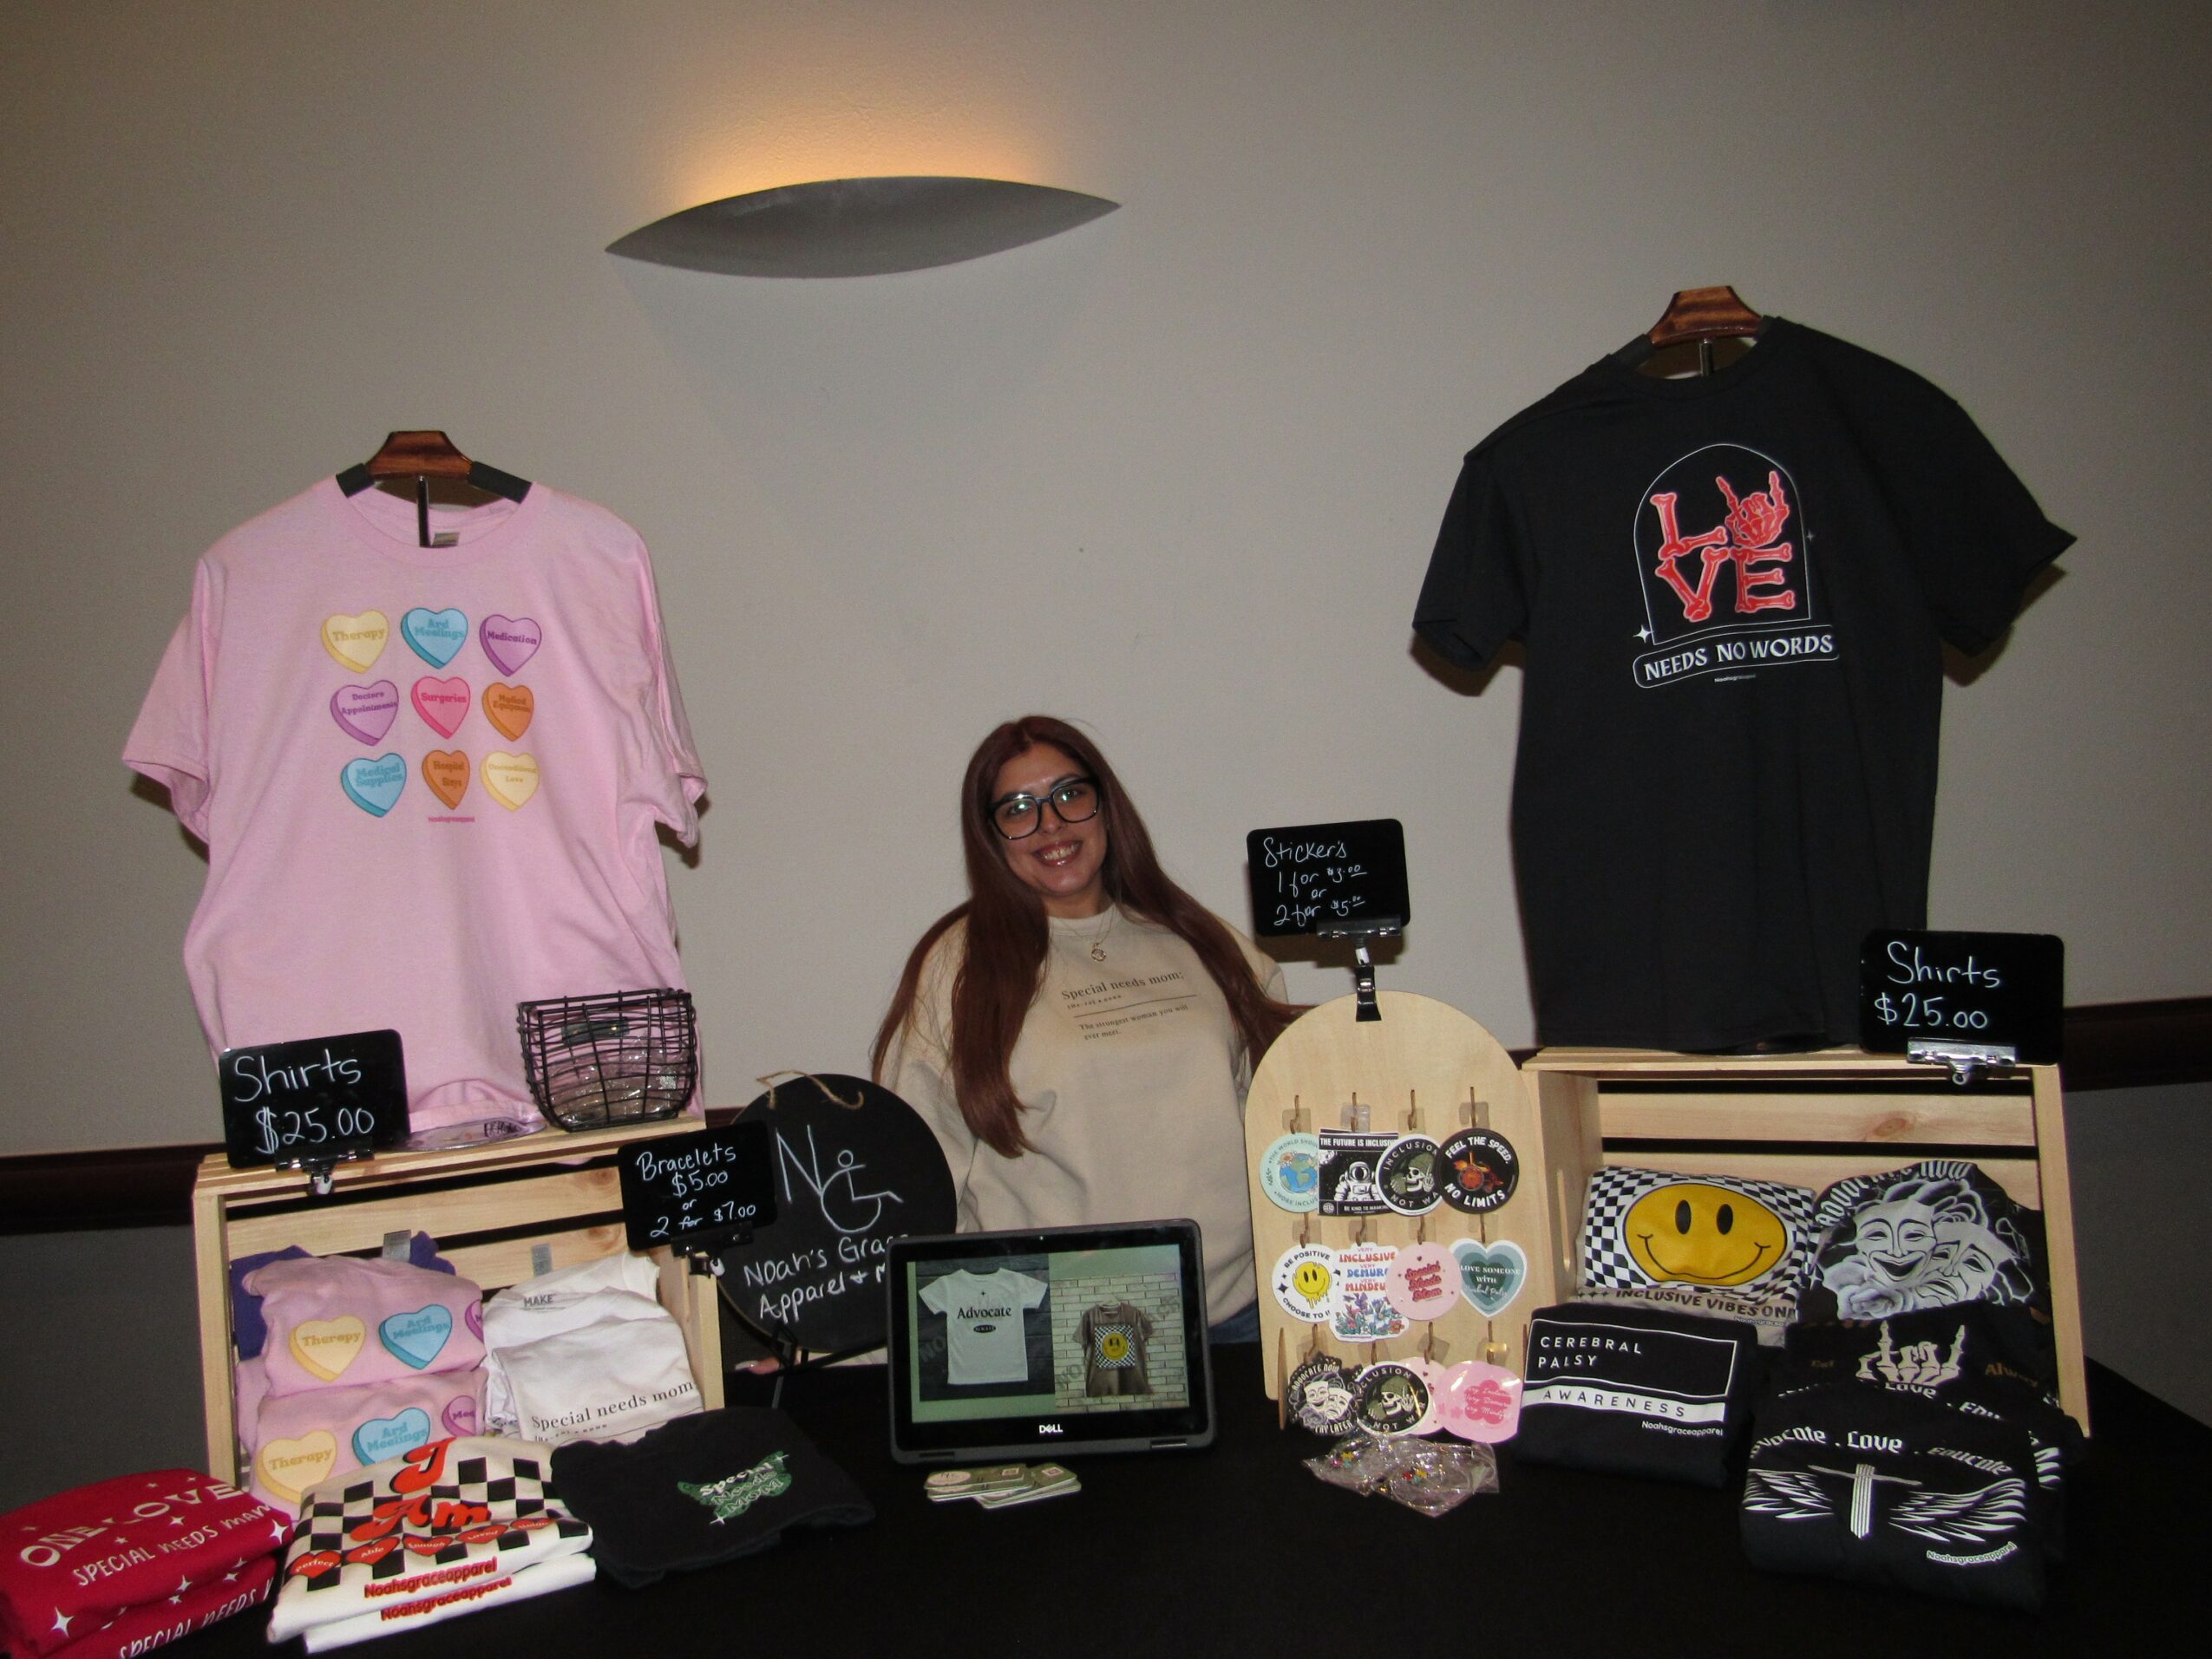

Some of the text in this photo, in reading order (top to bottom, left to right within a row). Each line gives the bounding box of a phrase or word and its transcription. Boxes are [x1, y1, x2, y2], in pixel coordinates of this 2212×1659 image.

[331, 629, 385, 641] Therapy
[487, 630, 537, 644] Medication
[1644, 634, 1833, 681] NEEDS NO WORDS
[421, 692, 467, 704] Surgeries
[1288, 871, 1319, 898] for
[1311, 888, 1327, 898] or
[1273, 905, 1291, 925] 2
[1290, 904, 1321, 926] for
[1887, 941, 2000, 988] Shirts
[1061, 982, 1108, 1001] Special
[1109, 976, 1146, 990] needs
[1080, 1004, 1188, 1031] The strongest woman you will
[1874, 991, 1988, 1029] $25.00
[234, 1048, 361, 1102] Shirts
[254, 1106, 375, 1154] $25.00
[1279, 1139, 1299, 1151] WORLD
[1332, 1137, 1356, 1146] FUTURE
[1358, 1138, 1364, 1146] IS
[1445, 1140, 1467, 1159] FEEL
[1467, 1136, 1487, 1146] THE
[636, 1142, 736, 1181] Bracelets
[671, 1169, 729, 1198] $5.00
[1444, 1182, 1506, 1207] NO LIMITS
[682, 1199, 697, 1211] or
[1391, 1194, 1414, 1208] NOT
[650, 1200, 756, 1238] 2 for $7.00
[743, 1248, 828, 1288] Noah's
[1284, 1251, 1331, 1269] BE POSITIVE
[1339, 1251, 1396, 1263] INCLUSIVE
[1405, 1260, 1441, 1281] Special
[1460, 1264, 1521, 1276] LOVE SOMEONE
[1409, 1275, 1442, 1291] Needs
[523, 1293, 553, 1308] MAKE
[760, 1271, 846, 1324] Apparel
[1282, 1297, 1311, 1318] CHOOSE
[1615, 1290, 1702, 1306] INCLUSIVE
[1706, 1298, 1758, 1316] VIBES
[406, 1316, 431, 1328] Ard
[957, 1306, 1011, 1320] Advocate
[301, 1330, 362, 1347] Therapy
[392, 1323, 449, 1340] Meetings
[1541, 1336, 1642, 1355] CEREBRAL
[1538, 1355, 1597, 1368] PALSY
[1291, 1363, 1340, 1390] ADVOCATE NOW
[531, 1408, 592, 1432] Special
[597, 1394, 647, 1418] needs
[652, 1381, 694, 1403] mom
[1543, 1389, 1685, 1418] AWARENESS
[382, 1422, 407, 1438] Ard
[1039, 1424, 1063, 1434] DELL
[1330, 1420, 1354, 1434] LATER
[1641, 1420, 1724, 1437] Noahsgraceapparel
[366, 1428, 428, 1452] Meetings
[1847, 1431, 1903, 1453] Love
[269, 1449, 332, 1470] Therapy
[350, 1494, 493, 1542] Am
[20, 1526, 108, 1567] ONE
[72, 1546, 155, 1586] SPECIAL
[157, 1525, 219, 1554] NEEDS
[1926, 1541, 2018, 1566] Noahsgraceapparel
[363, 1556, 498, 1599] Noahsgraceapparel
[379, 1576, 514, 1622] Noahsgraceapparel
[120, 1618, 192, 1659] SPECIAL
[202, 1589, 257, 1629] NEEDS
